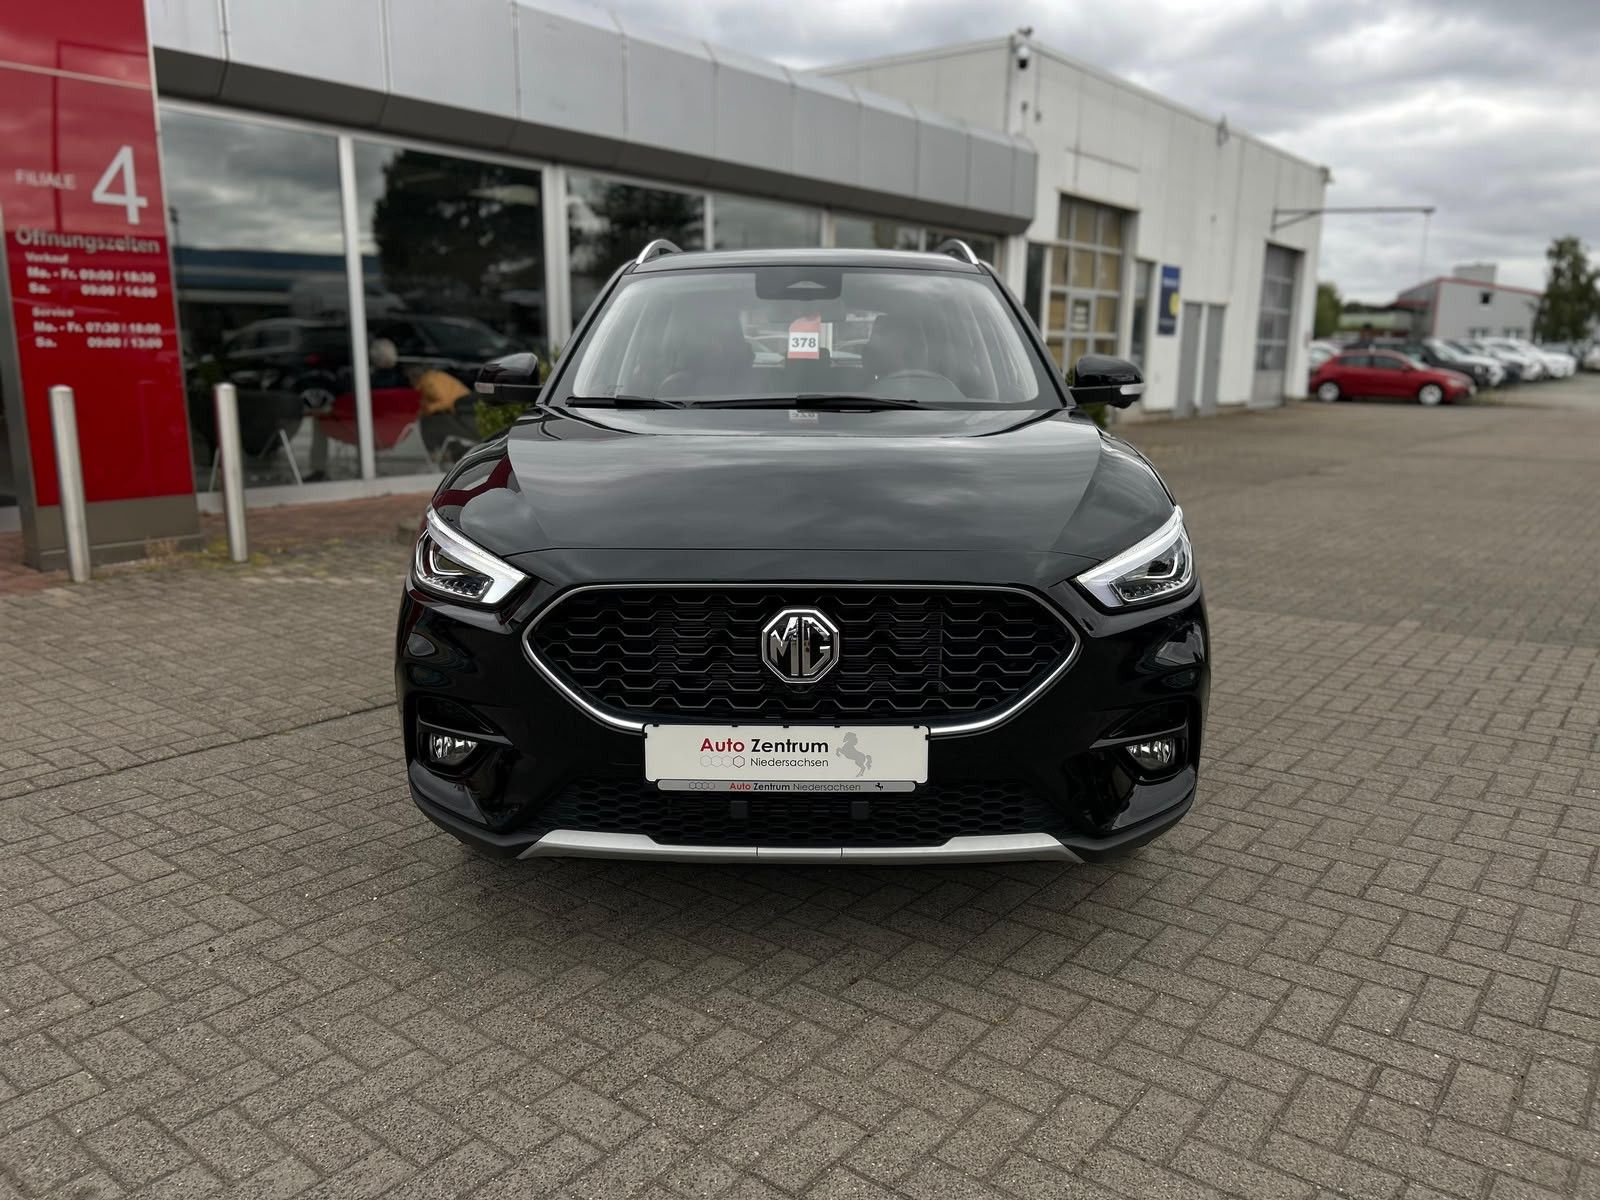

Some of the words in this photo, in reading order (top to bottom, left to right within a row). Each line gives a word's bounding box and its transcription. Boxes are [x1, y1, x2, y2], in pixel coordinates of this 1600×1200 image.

[15, 168, 77, 190] FILIALE
[91, 144, 149, 225] 4
[14, 225, 161, 254] Öffnungszeiten
[791, 337, 817, 349] 378
[769, 615, 831, 677] MG
[700, 738, 745, 753] Auto
[750, 738, 829, 754] Zentrum
[750, 757, 829, 768] Niedersachsen
[729, 782, 751, 791] Auto
[753, 782, 790, 791] Zentrum
[793, 782, 862, 792] Niedersachsen
